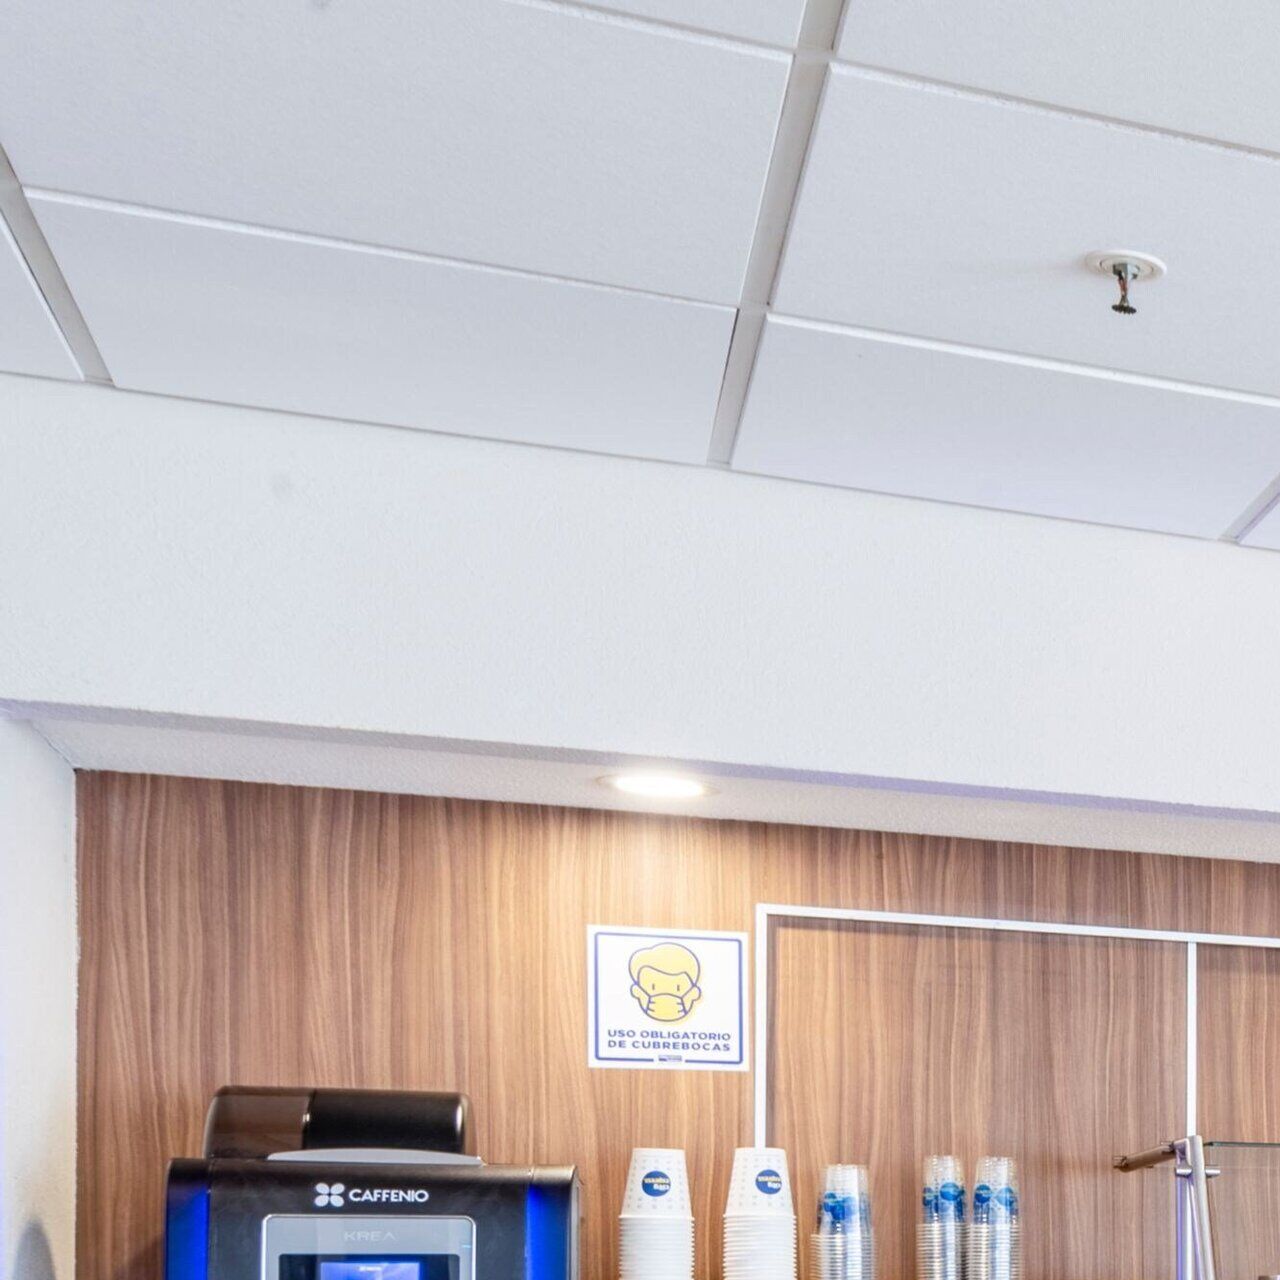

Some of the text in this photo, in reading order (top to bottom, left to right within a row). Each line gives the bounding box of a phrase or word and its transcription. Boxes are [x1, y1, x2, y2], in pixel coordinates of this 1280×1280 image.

[607, 1029, 731, 1041] USO OBLIGATORIO
[607, 1040, 731, 1051] DE CUBREBOCAS
[348, 1188, 430, 1203] CAFFENIO
[344, 1230, 398, 1242] KREA
